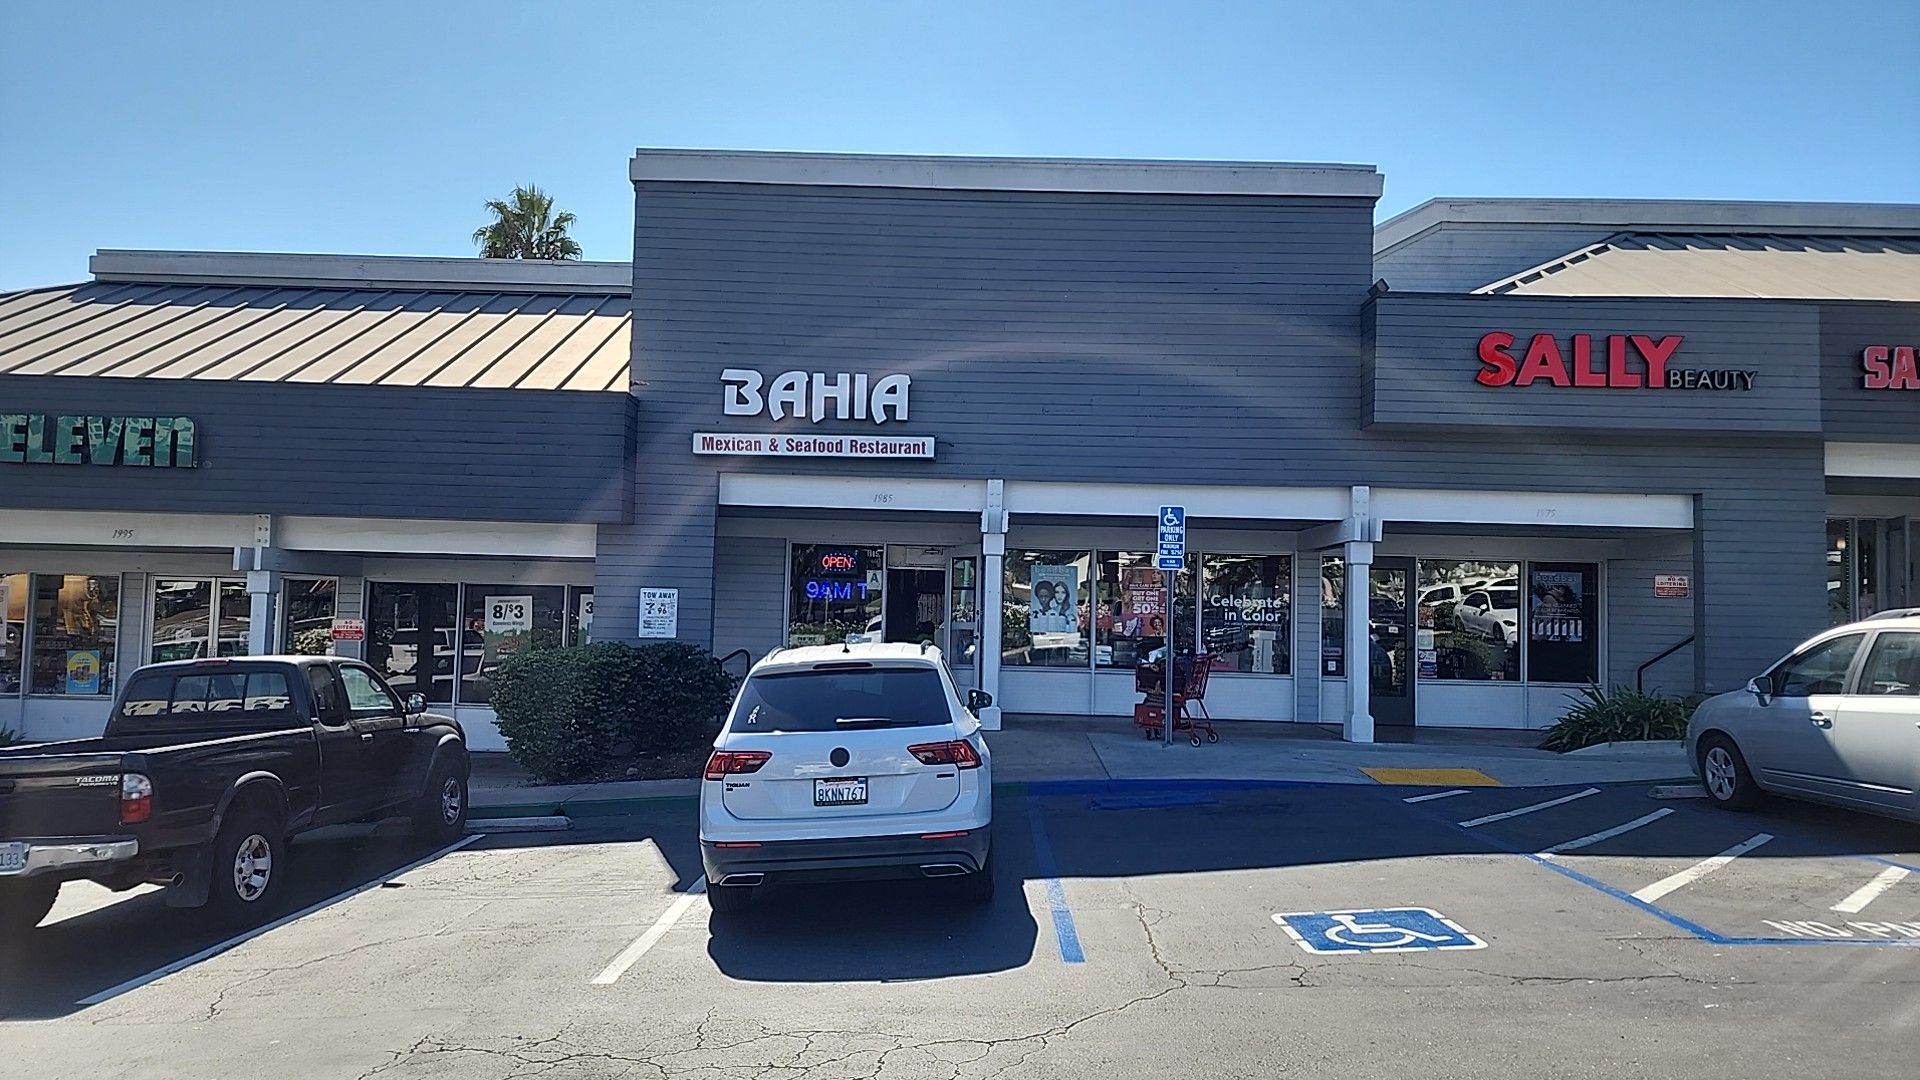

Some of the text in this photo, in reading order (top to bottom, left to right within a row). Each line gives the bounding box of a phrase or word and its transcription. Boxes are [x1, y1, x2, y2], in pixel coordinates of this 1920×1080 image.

[1476, 332, 1758, 389] SALLY BEAUTY
[720, 368, 912, 424] BAHIA
[702, 436, 927, 455] Mexican & Seafood Restaurant
[873, 494, 893, 503] 1985
[112, 529, 134, 539] 1995
[1160, 525, 1184, 534] PARKING
[1164, 533, 1179, 542] ONLY
[822, 556, 852, 568] OPEN
[870, 573, 879, 583] A
[643, 591, 657, 599] TOW
[806, 581, 852, 600] 9AM
[1132, 601, 1160, 614] 50%
[1210, 594, 1282, 608] Celebrate
[492, 603, 525, 620] 8/$3
[1224, 608, 1281, 621] in Color
[75, 775, 119, 784] TACOMA
[817, 786, 865, 801] 8KNN767
[1762, 920, 1854, 937] NO
